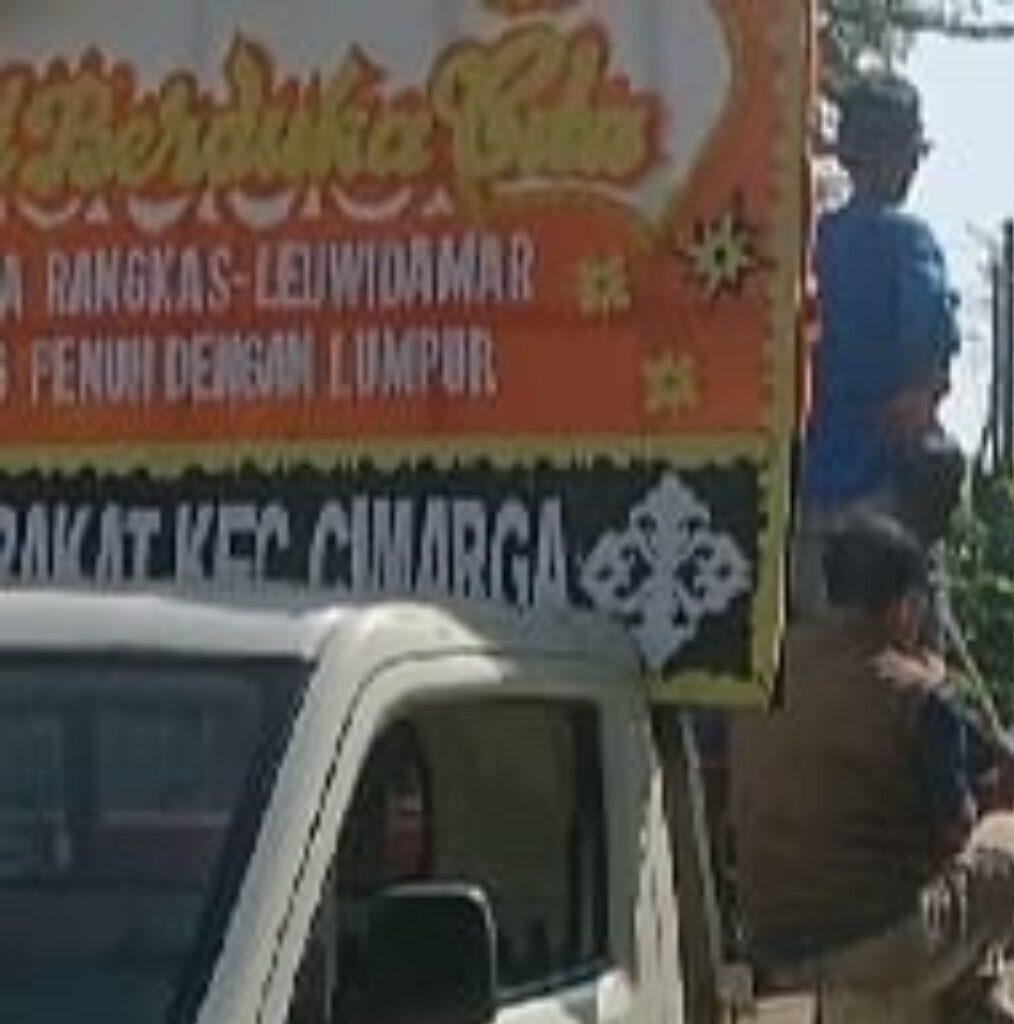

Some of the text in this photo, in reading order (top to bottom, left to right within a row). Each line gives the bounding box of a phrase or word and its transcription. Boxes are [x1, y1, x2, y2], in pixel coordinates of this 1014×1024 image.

[20, 36, 432, 188] Berduka
[31, 332, 154, 406] PENUH
[163, 328, 314, 402] DENGAN
[329, 325, 498, 400] LUMPUR
[308, 496, 567, 608] CIMARGA
